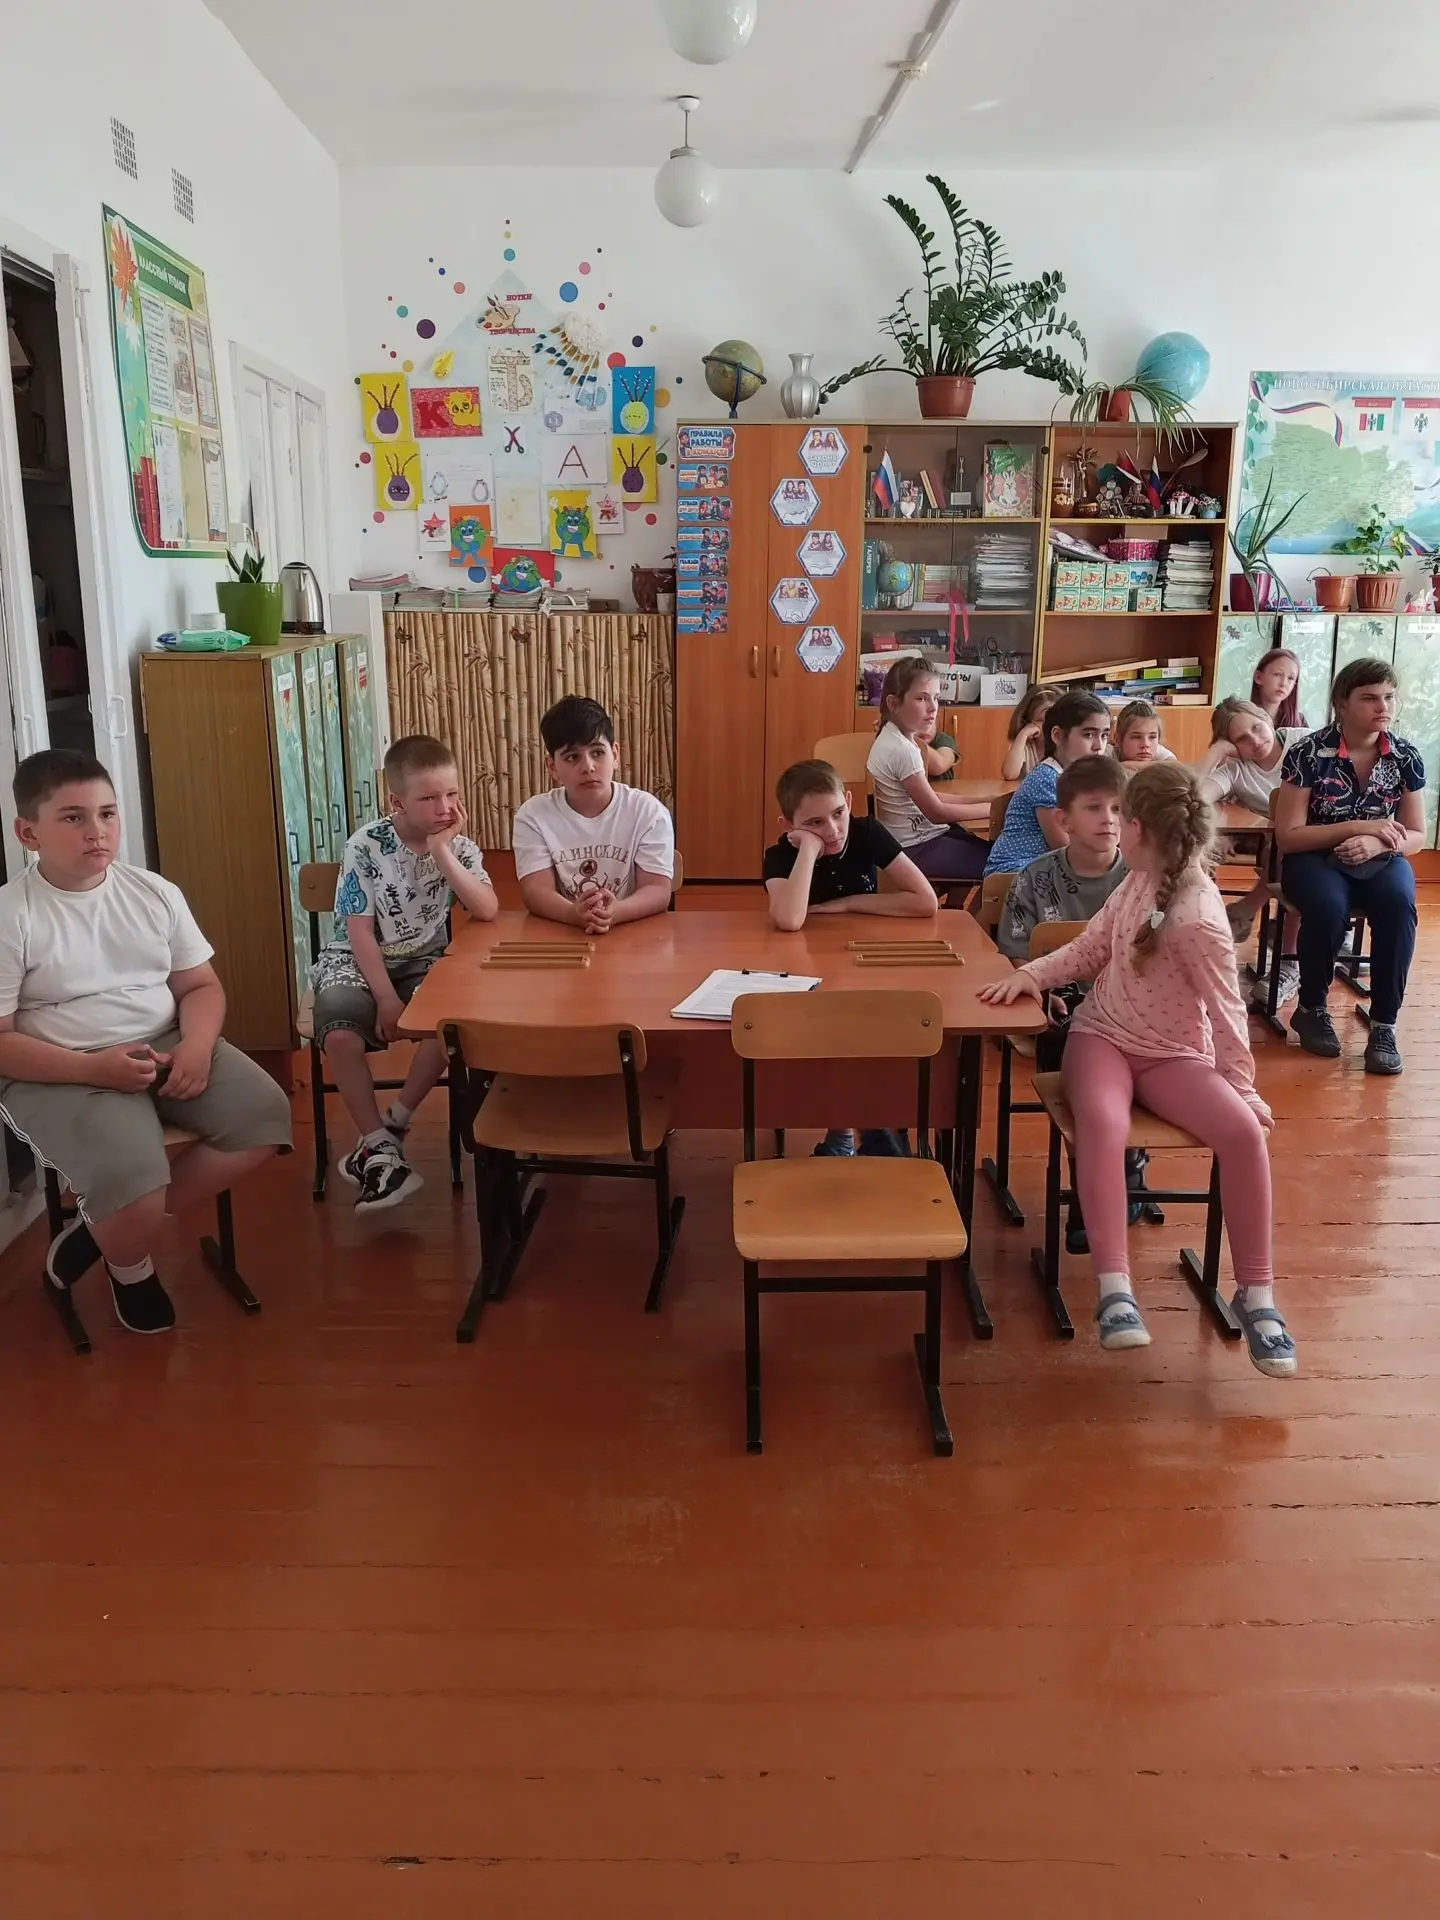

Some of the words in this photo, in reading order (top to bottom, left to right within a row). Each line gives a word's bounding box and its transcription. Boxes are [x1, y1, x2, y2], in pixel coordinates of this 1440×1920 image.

[506, 293, 533, 302] НОТКИ
[489, 327, 536, 336] ТВОРЧЕСТВА
[1273, 379, 1384, 391] НОВОСИБИРСКАЯ
[690, 439, 722, 447] РАБОТЫ
